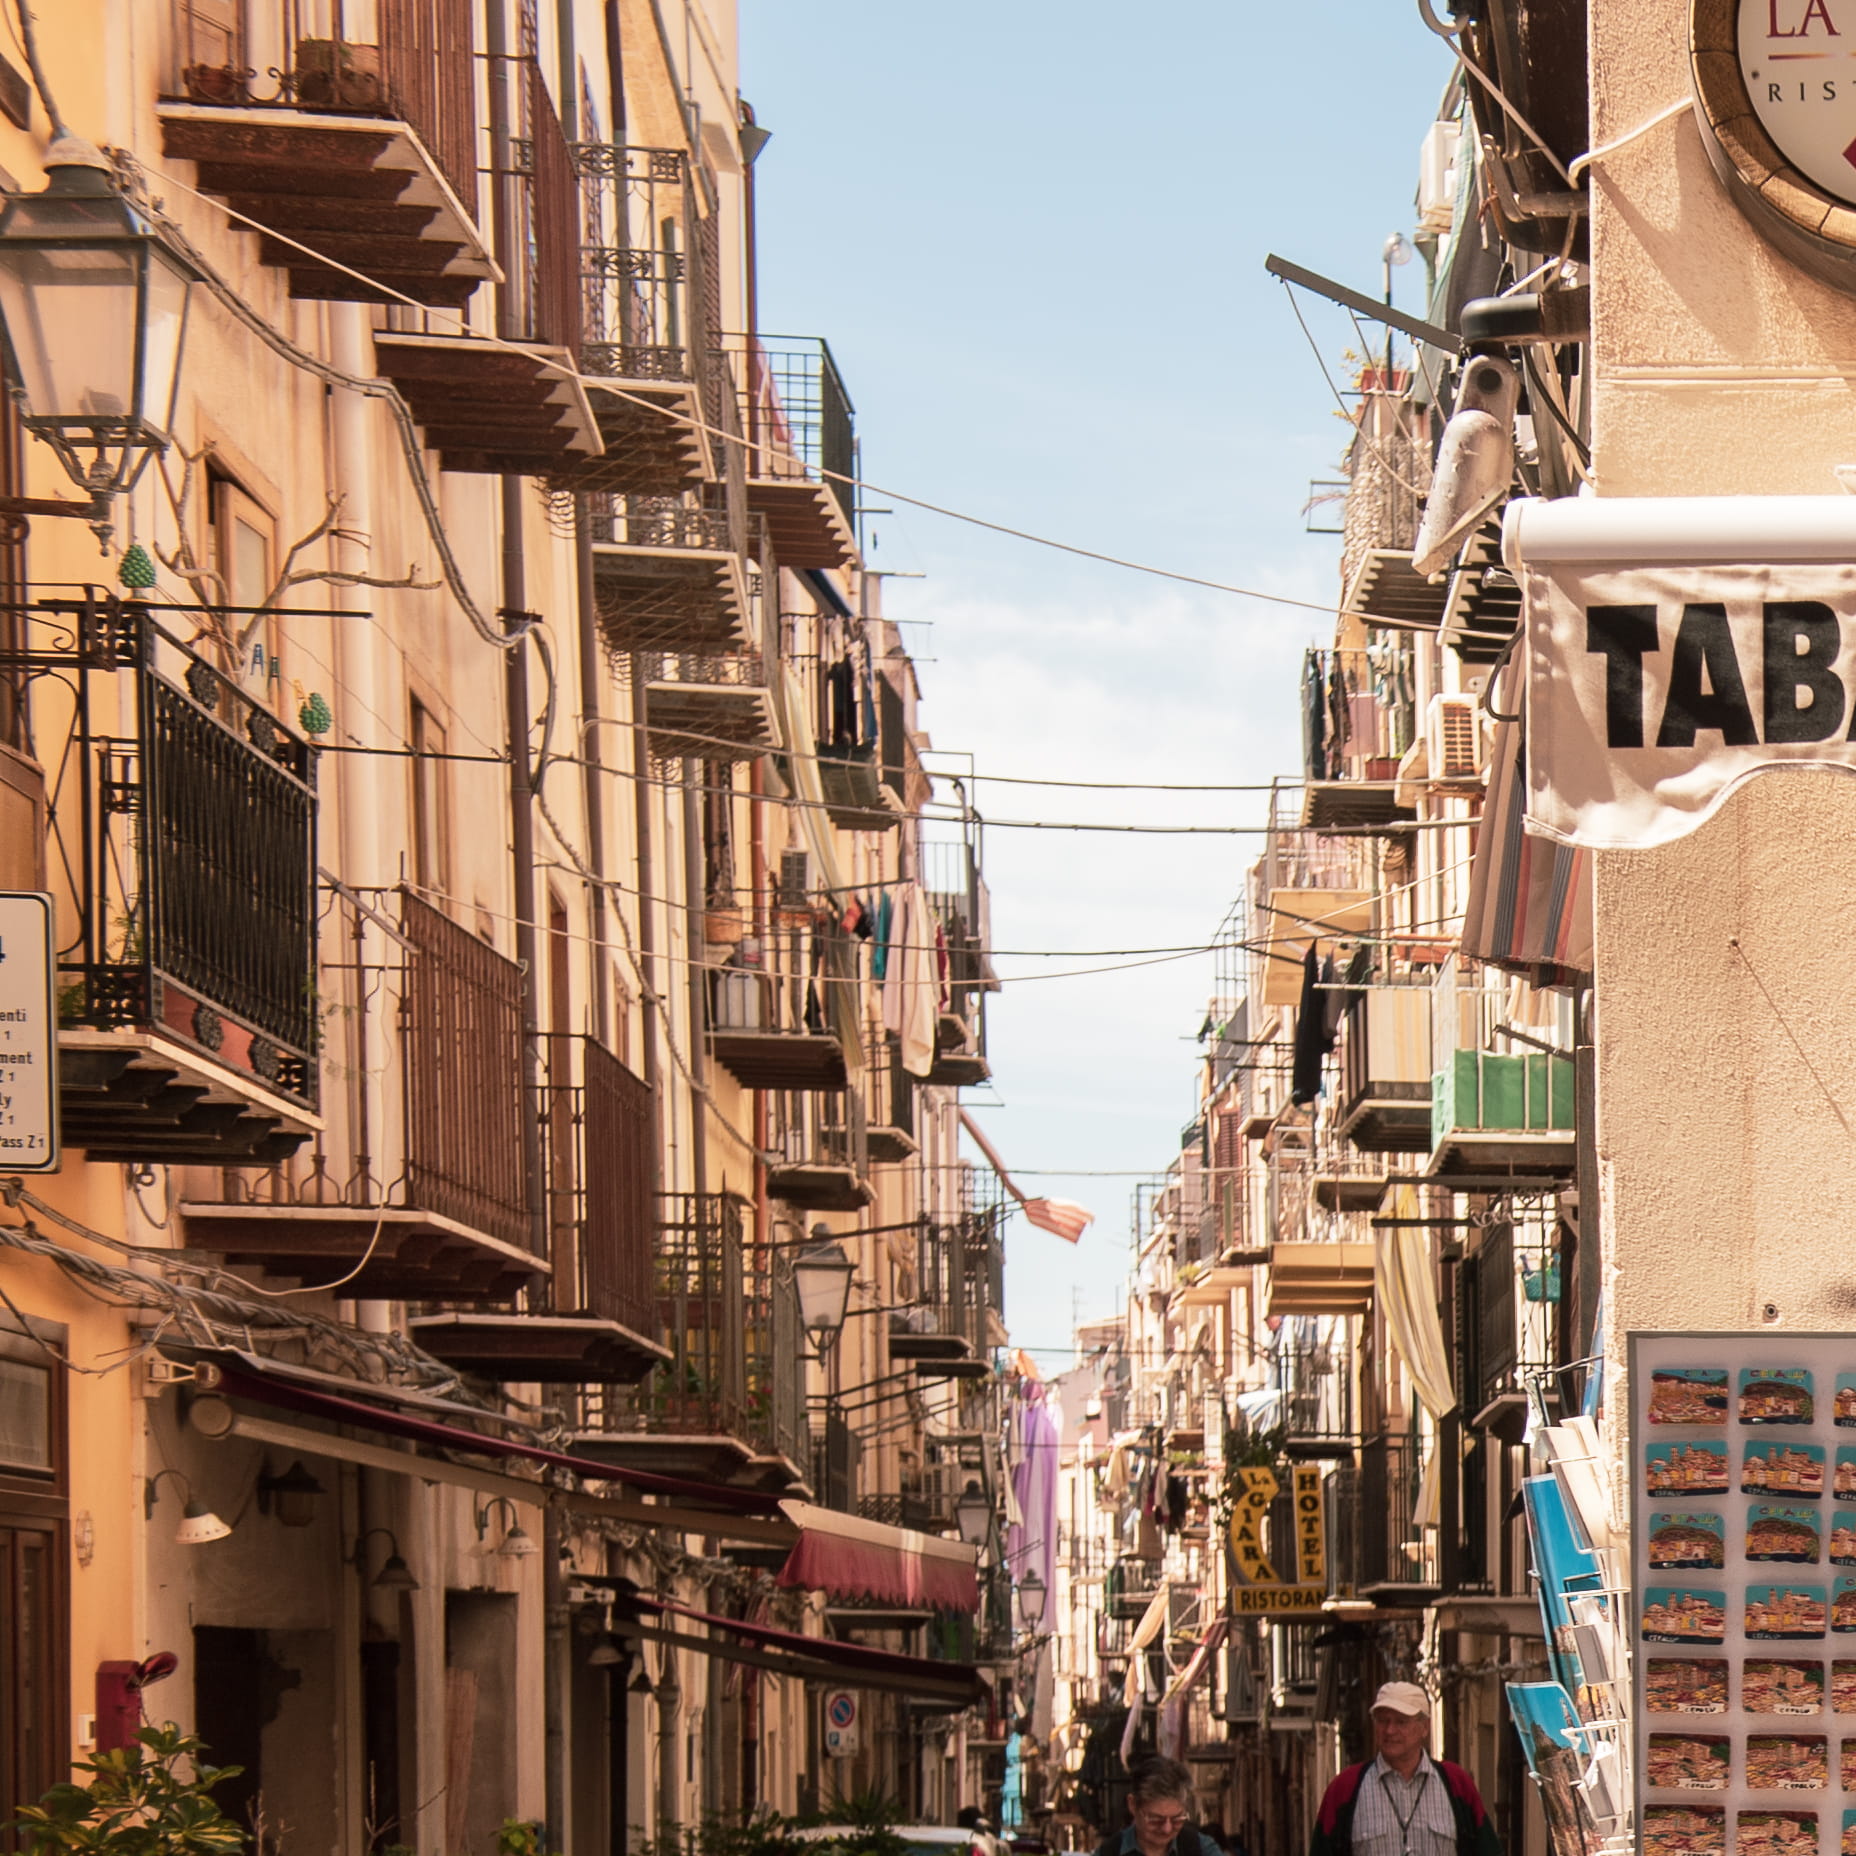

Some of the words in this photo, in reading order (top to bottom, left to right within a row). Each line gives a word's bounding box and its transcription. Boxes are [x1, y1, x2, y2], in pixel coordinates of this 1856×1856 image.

[1766, 0, 1840, 38] LA
[1237, 1492, 1273, 1579] GIARA
[1298, 1473, 1321, 1577] HOTEL
